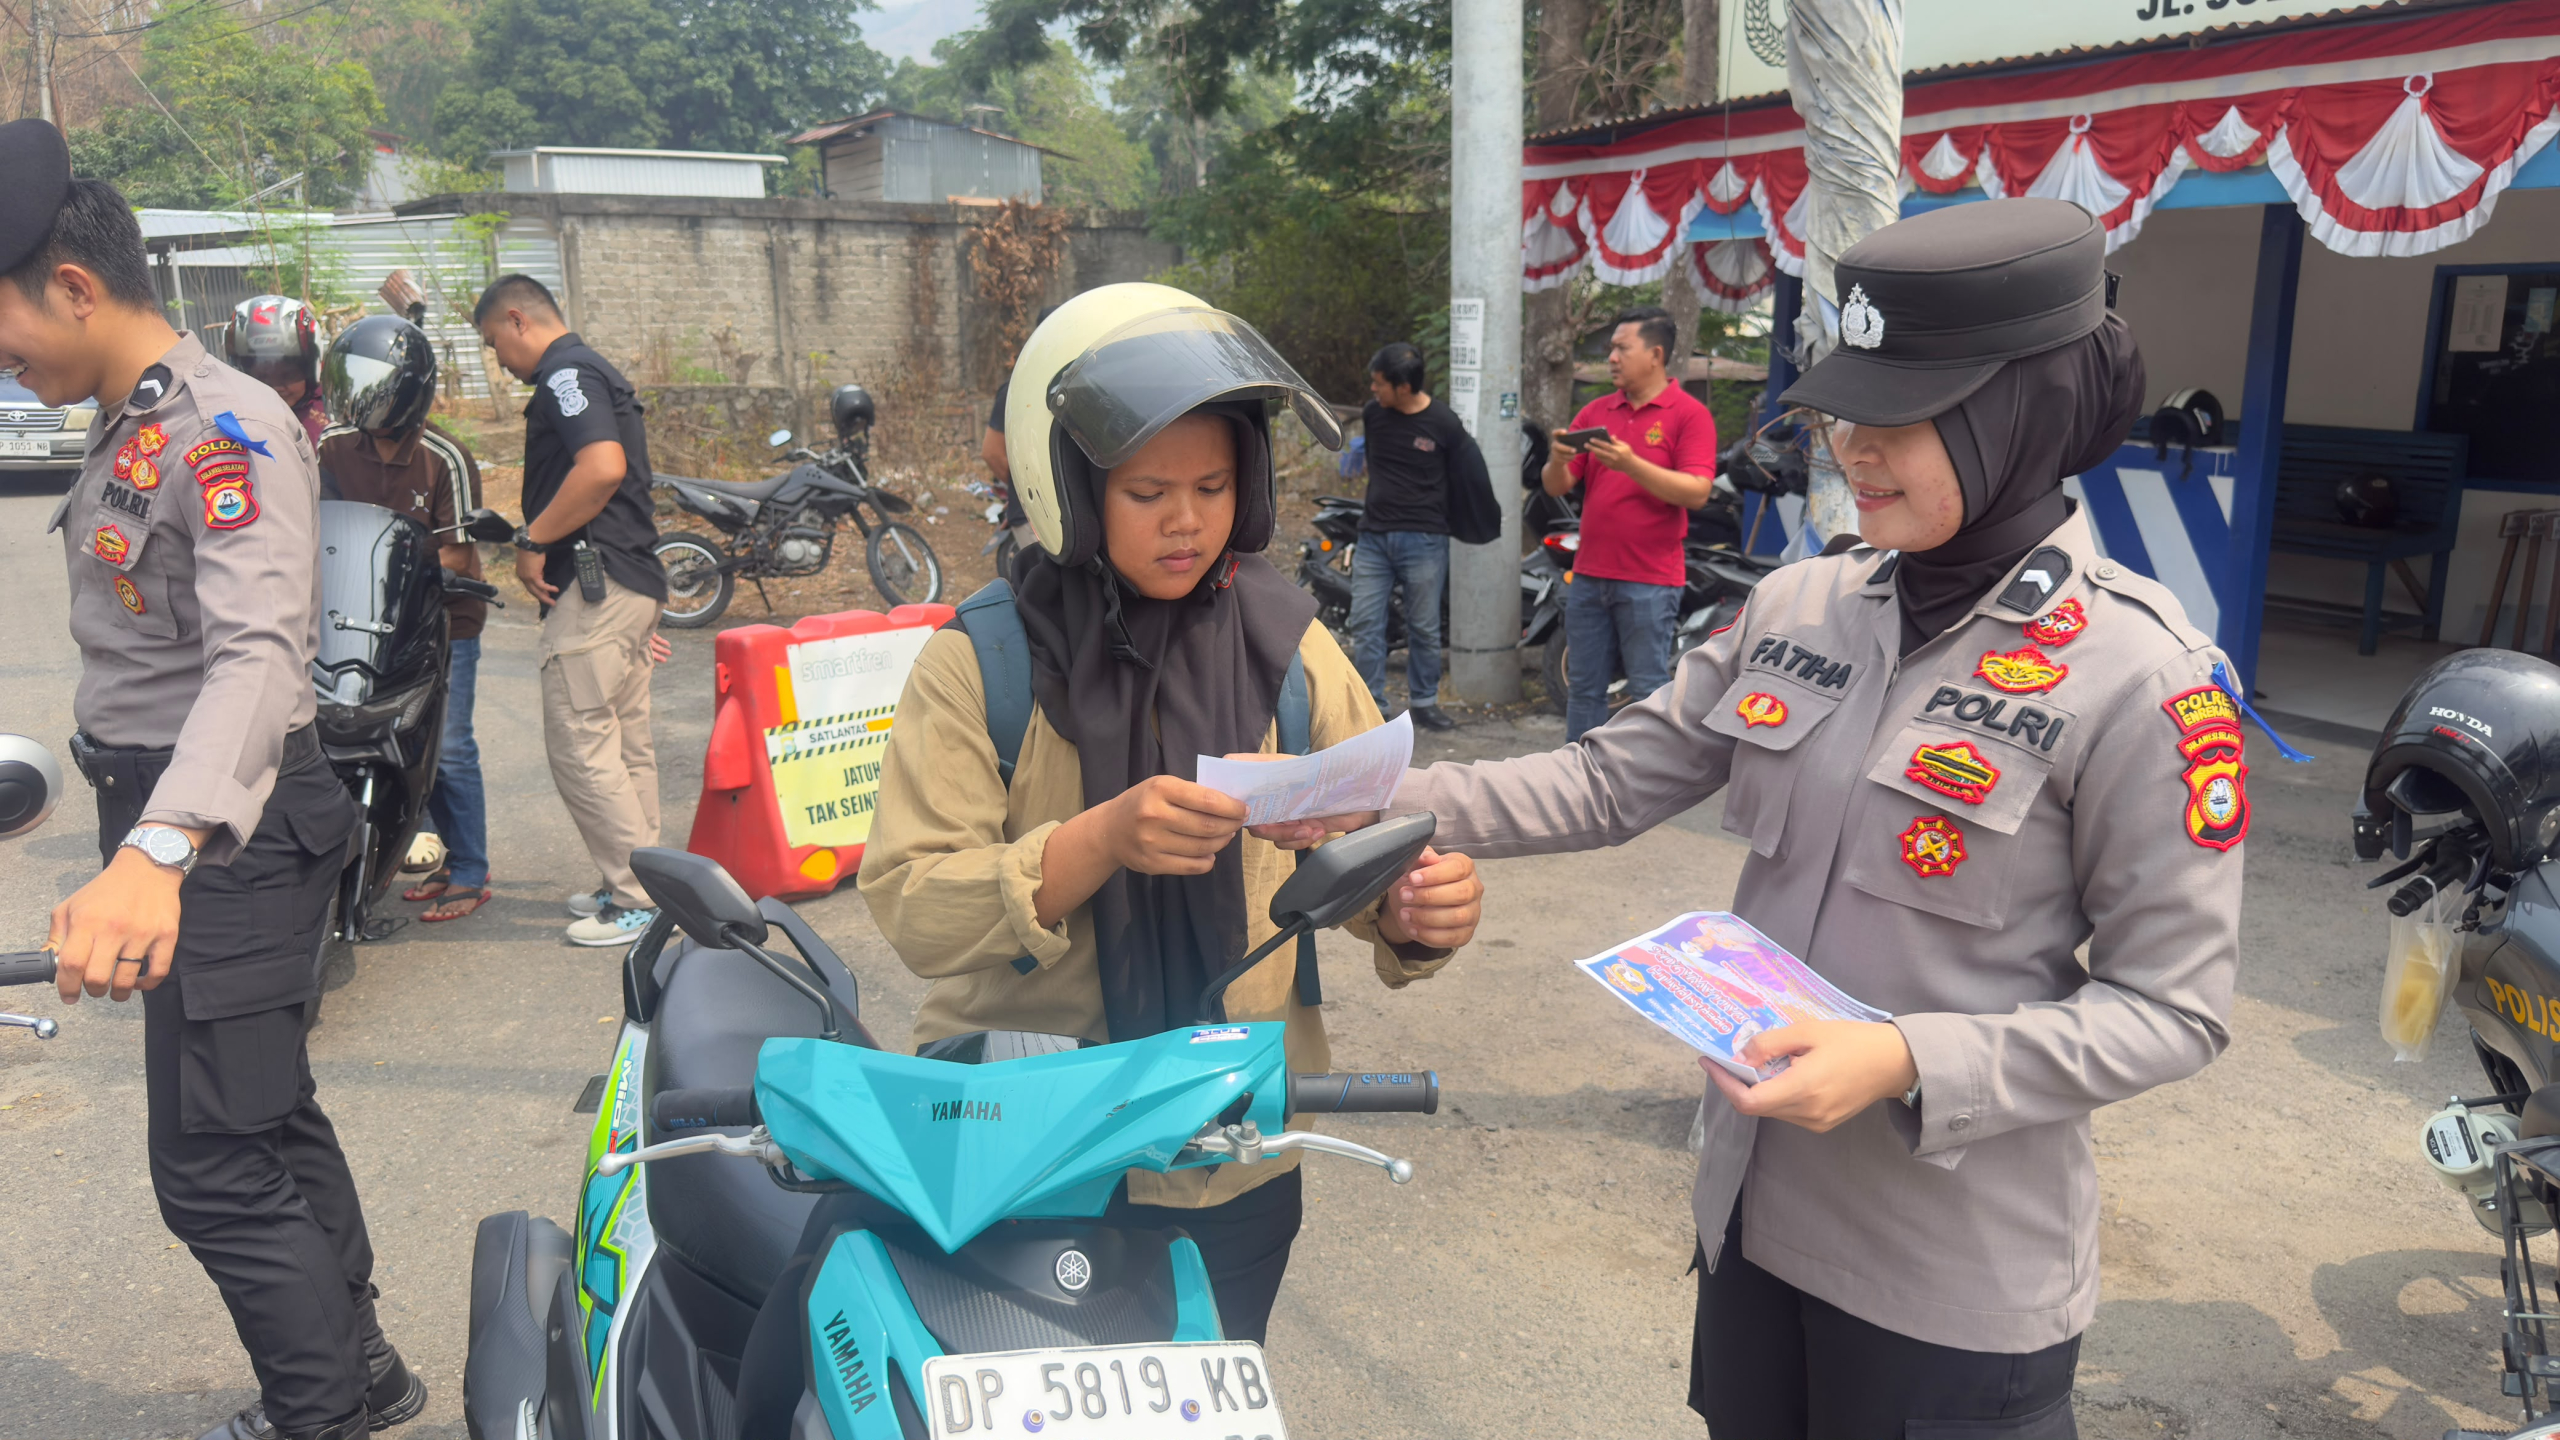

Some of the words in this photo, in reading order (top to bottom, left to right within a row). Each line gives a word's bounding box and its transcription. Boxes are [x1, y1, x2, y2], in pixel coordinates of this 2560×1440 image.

[188, 439, 243, 464] POLDA
[101, 480, 150, 519] POLRI
[802, 648, 893, 682] smartfren
[1750, 637, 1852, 690] FATIHA
[1925, 685, 2065, 751] POLRI
[2175, 690, 2235, 716] POLRE
[809, 723, 868, 744] SATLANTAS
[2429, 706, 2493, 738] HONDA
[843, 761, 881, 787] JATUH
[805, 801, 838, 825] TAK
[1646, 964, 1692, 1000] PATUH
[1683, 992, 1734, 1035] OPERASI
[931, 1100, 1002, 1122] YAMAHA
[823, 1309, 878, 1415] YAMAHA
[939, 1368, 1004, 1434] DP
[1040, 1356, 1172, 1422] 5819
[1200, 1356, 1269, 1413] KB
